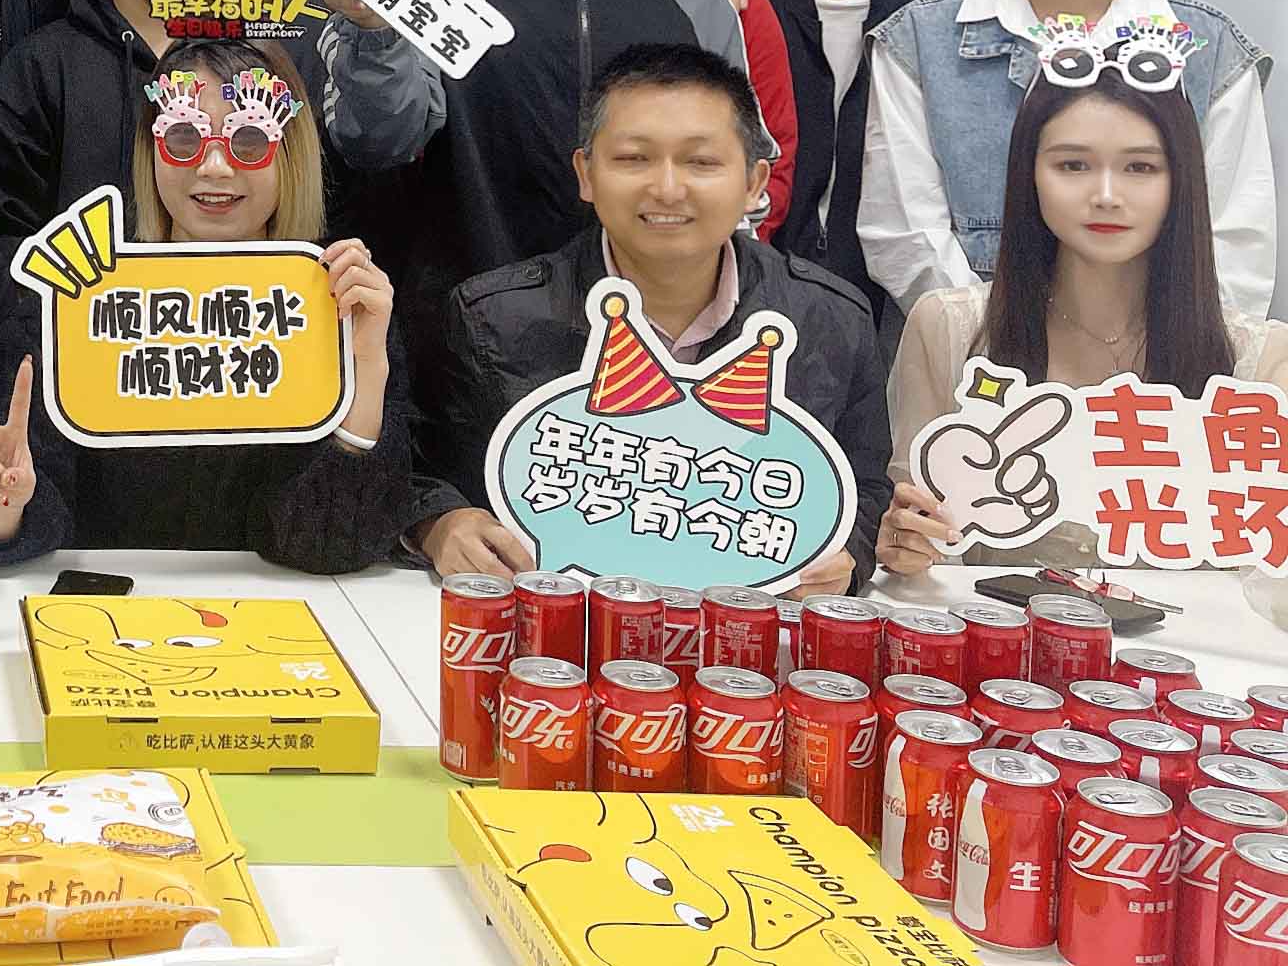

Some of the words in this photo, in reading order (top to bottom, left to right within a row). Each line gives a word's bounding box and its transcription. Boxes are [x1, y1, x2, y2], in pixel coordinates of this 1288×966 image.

[92, 289, 304, 339] 顺风顺水
[121, 344, 280, 396] 顺财神
[1086, 384, 1288, 473] 主角
[530, 412, 804, 511] 年年有今日
[522, 464, 797, 564] 岁岁有今朝
[1096, 479, 1288, 568] 光环
[66, 685, 153, 698] pizza
[169, 687, 341, 700] Champion
[145, 733, 315, 752] 吃比萨,认准这头大黄象
[749, 806, 858, 906] Champion
[1009, 861, 1041, 891] 生
[65, 875, 124, 907] Food
